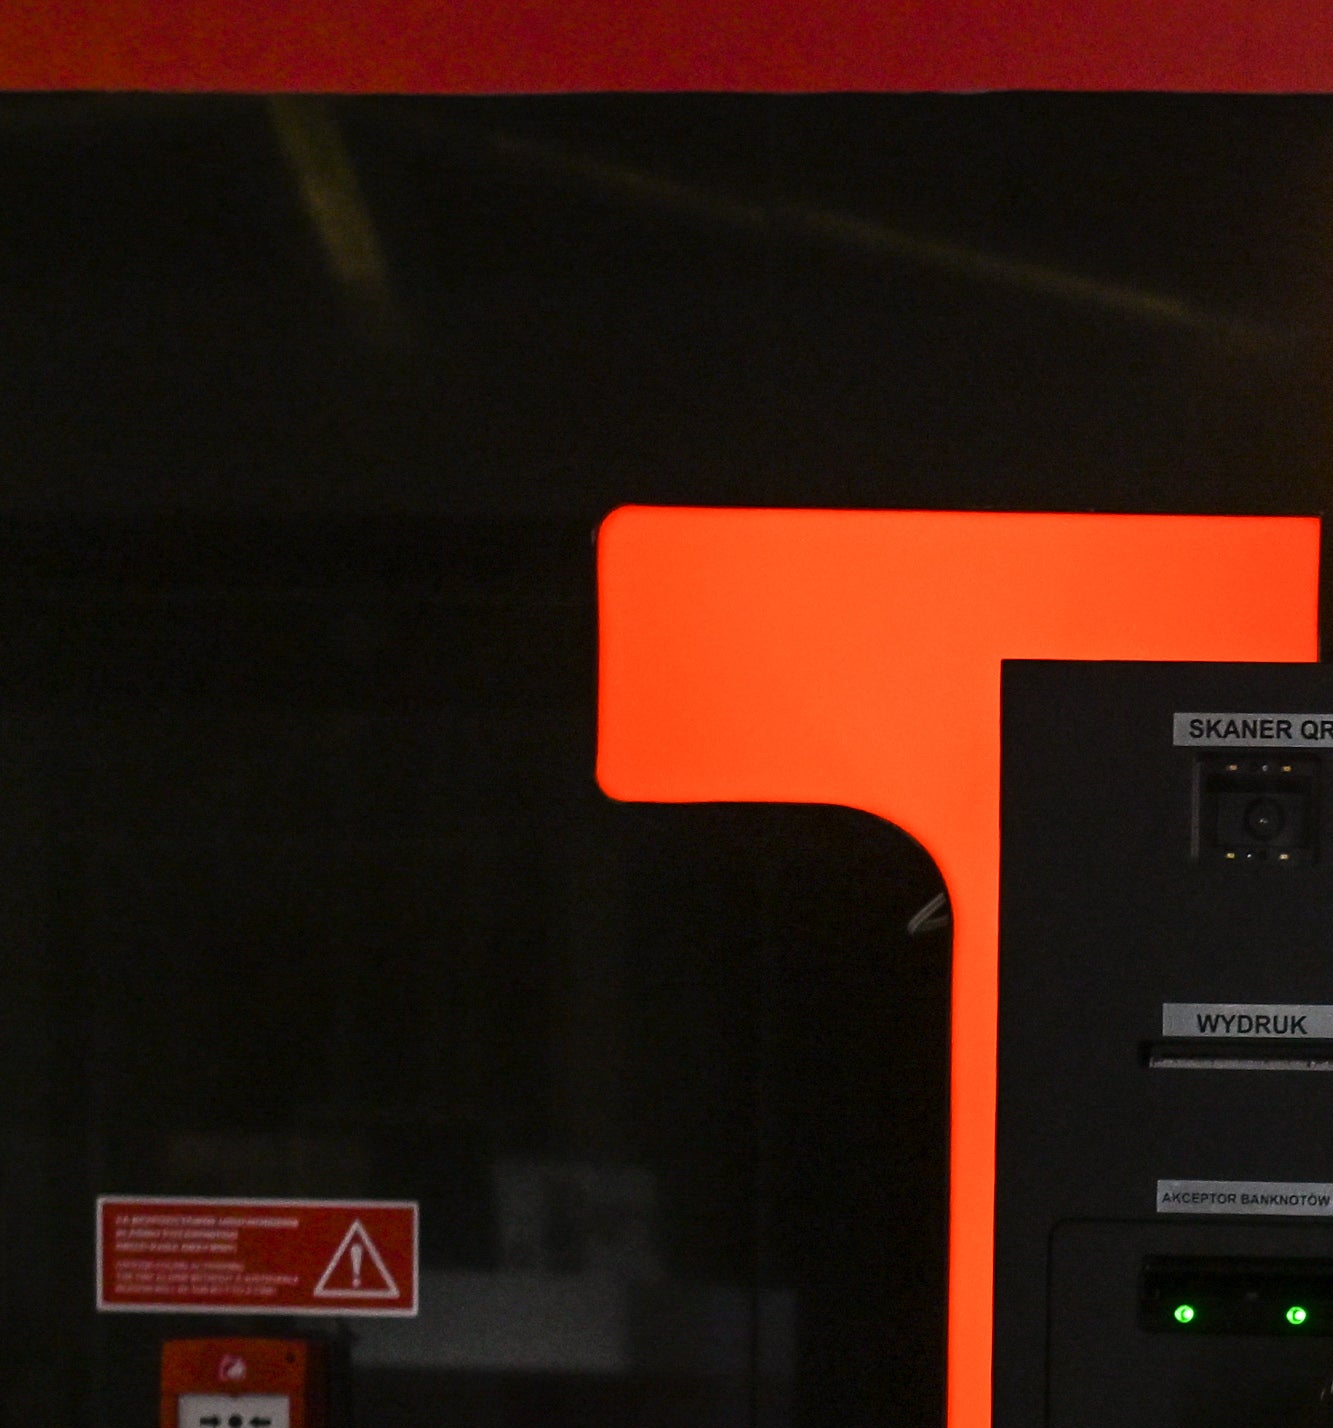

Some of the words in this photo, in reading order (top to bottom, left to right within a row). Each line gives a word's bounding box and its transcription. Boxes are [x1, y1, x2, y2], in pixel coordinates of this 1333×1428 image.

[1189, 718, 1293, 739] SKANER
[1196, 1013, 1309, 1035] WYDRUK
[1161, 1192, 1237, 1205] AKCEPTOR
